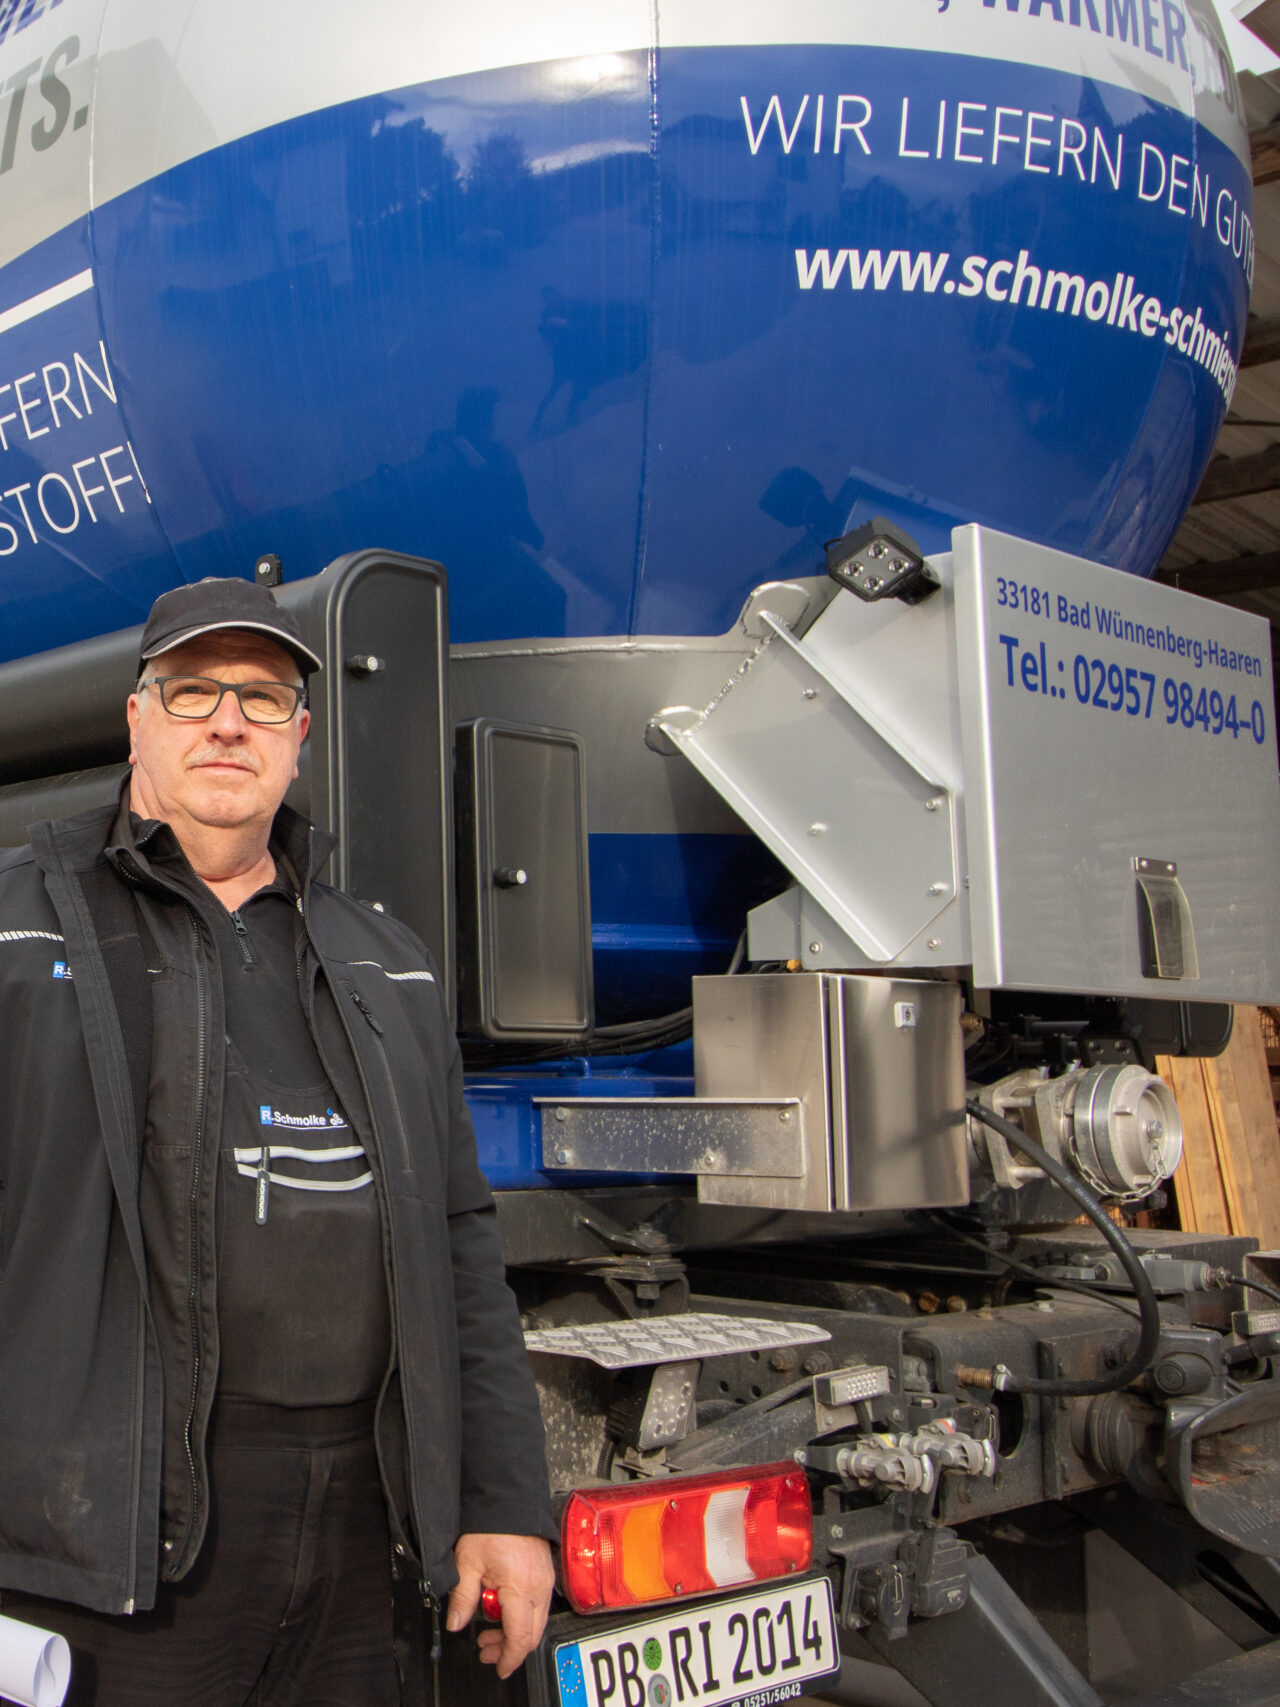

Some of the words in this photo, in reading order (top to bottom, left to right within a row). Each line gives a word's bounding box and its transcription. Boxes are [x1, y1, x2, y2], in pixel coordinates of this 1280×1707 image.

[740, 94, 872, 156] WIR
[898, 97, 1123, 190] LIEFERN
[1137, 143, 1209, 228] DEN
[996, 577, 1050, 619] 33181
[1057, 595, 1091, 630] Bad
[1095, 605, 1262, 677] Wünnenberg-Haaren
[999, 634, 1066, 700] Tel.:
[1073, 654, 1156, 719] 02957
[1163, 678, 1265, 745] 98494-0
[261, 1110, 326, 1126] R.Schmolke
[589, 1642, 646, 1707] PB
[669, 1620, 720, 1702] RI
[727, 1594, 823, 1684] 2014
[744, 1682, 802, 1707] 05251/56042
